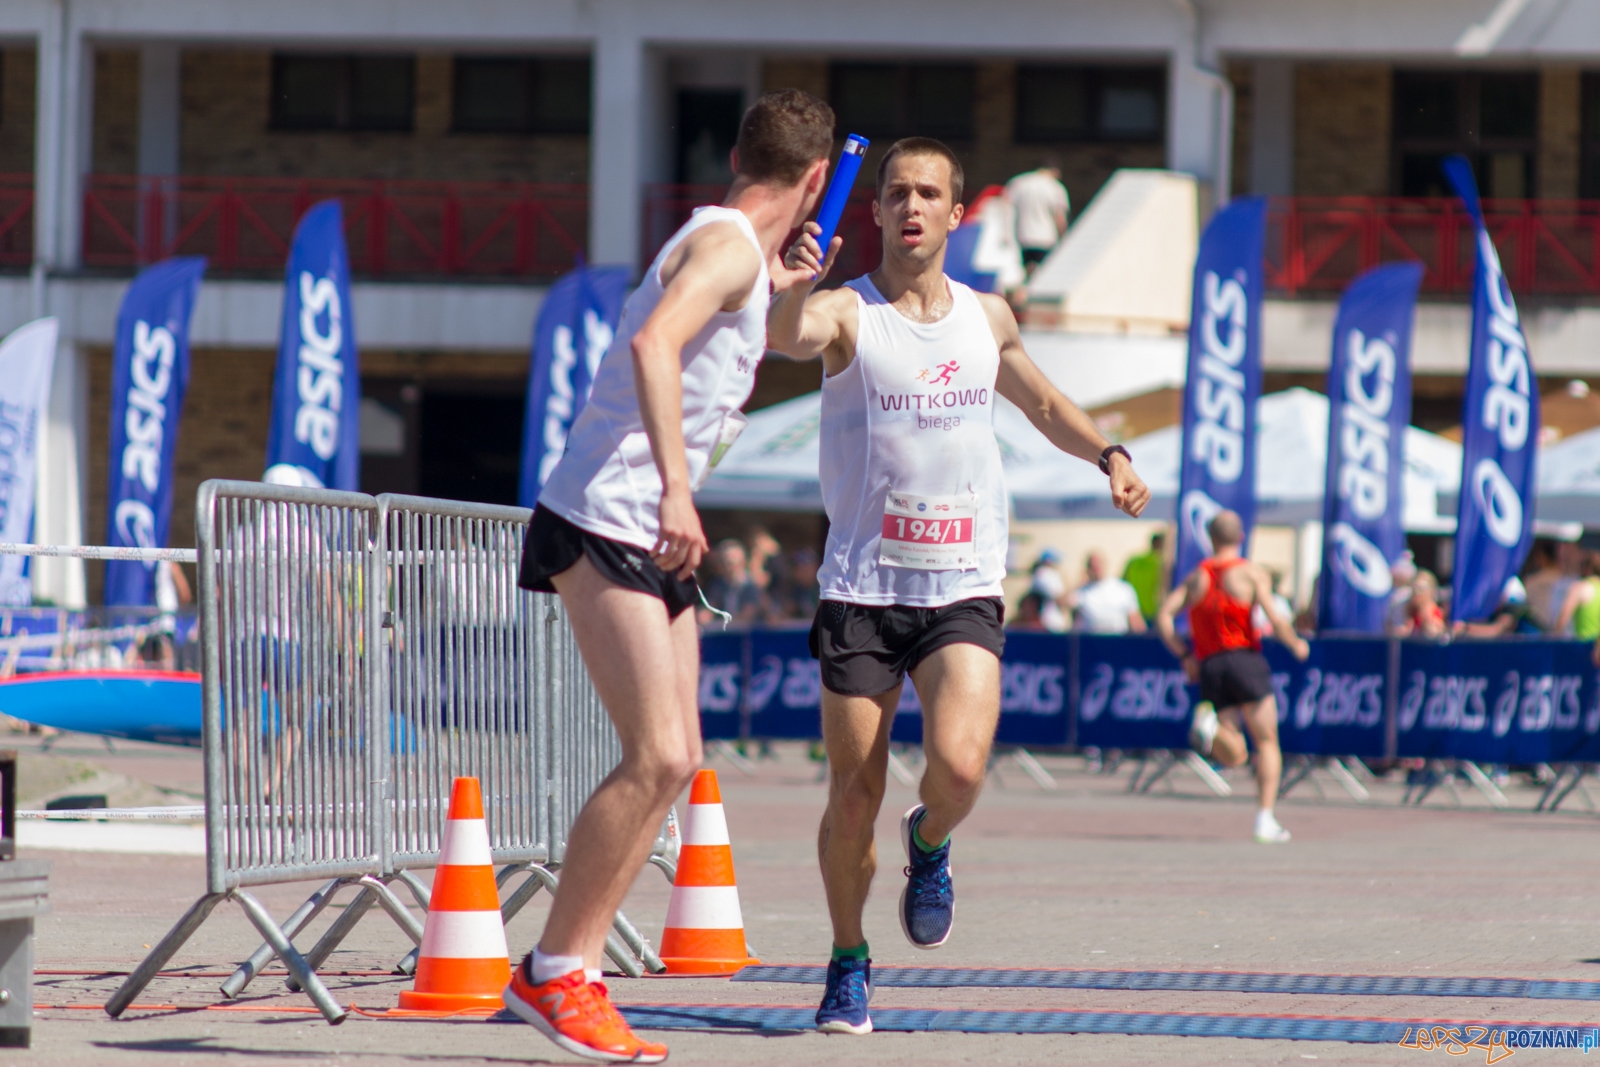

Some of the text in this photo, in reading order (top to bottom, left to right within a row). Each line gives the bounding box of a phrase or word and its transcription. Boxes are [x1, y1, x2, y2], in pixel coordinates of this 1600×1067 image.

[880, 388, 988, 411] WITKOWO
[918, 415, 961, 431] biega
[895, 517, 962, 544] 194/1
